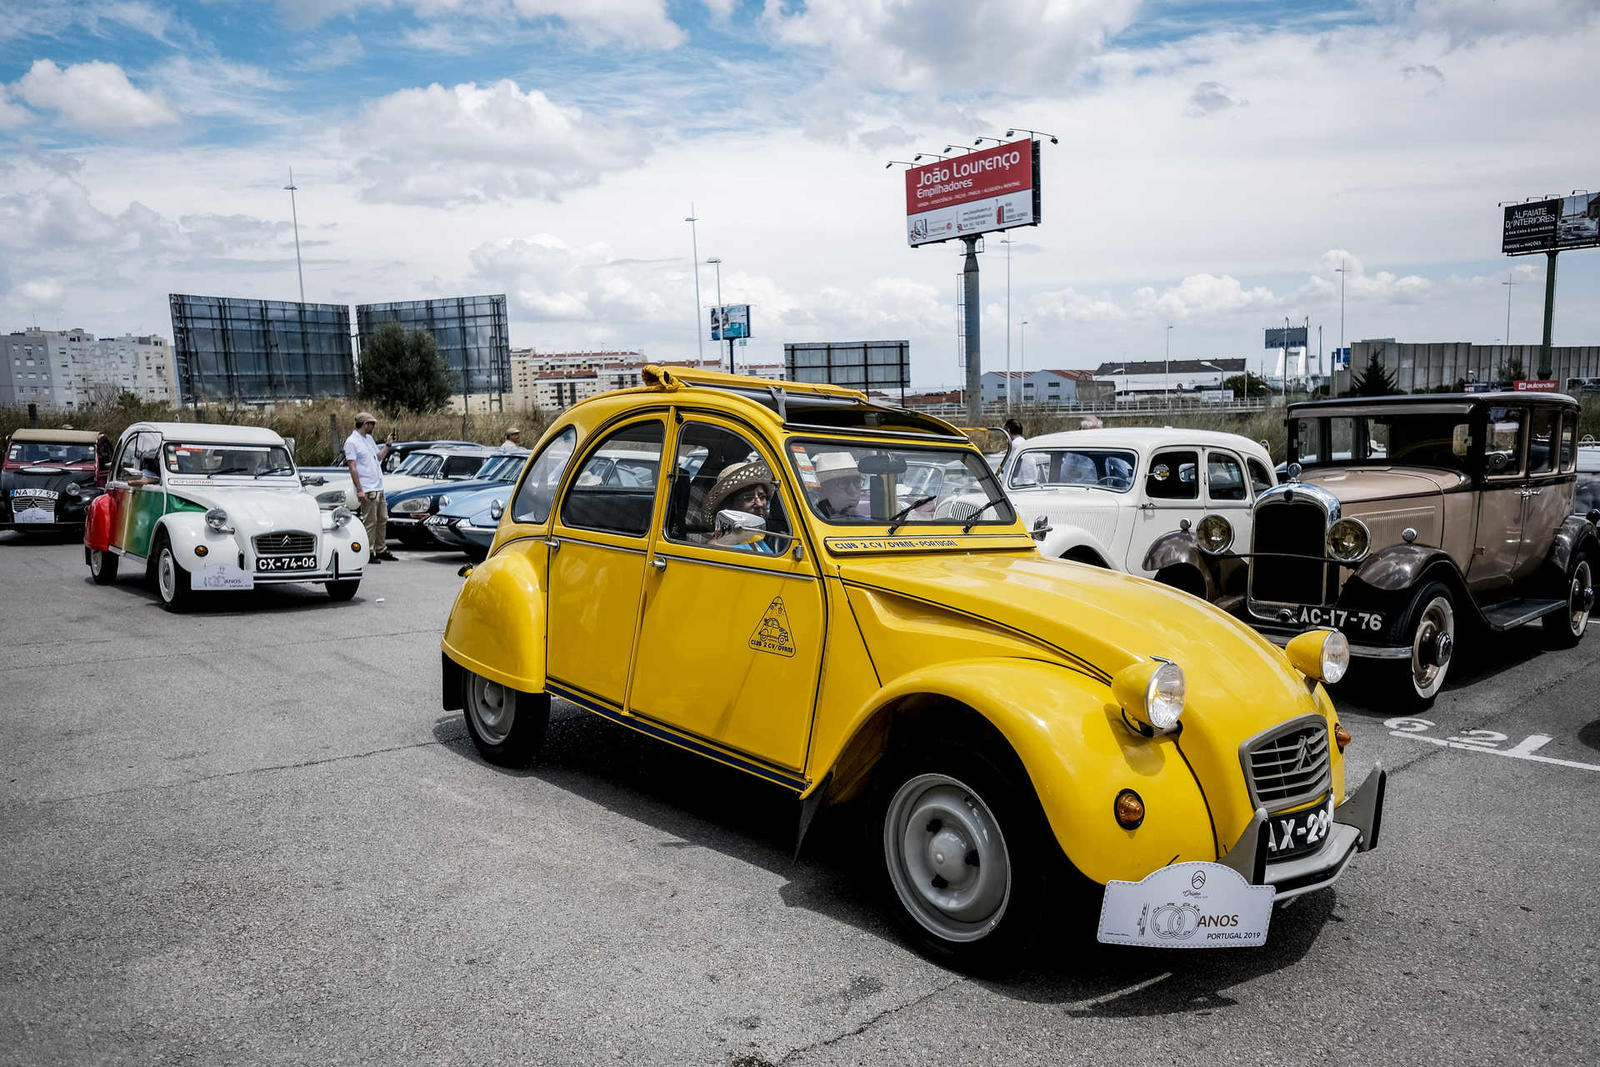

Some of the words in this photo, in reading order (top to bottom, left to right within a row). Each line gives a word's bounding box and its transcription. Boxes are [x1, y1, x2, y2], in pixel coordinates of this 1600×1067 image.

[917, 167, 950, 188] João
[953, 151, 1020, 178] Lourenço
[917, 179, 973, 198] Empilhadores
[1513, 207, 1548, 220] ALFAIATE
[834, 542, 859, 550] CLUB
[259, 557, 316, 570] CX-74-06
[1300, 606, 1383, 631] AC-17-76
[1197, 914, 1239, 928] ANOS
[1206, 932, 1243, 940] PORTUGAL
[1243, 931, 1261, 939] 2019
